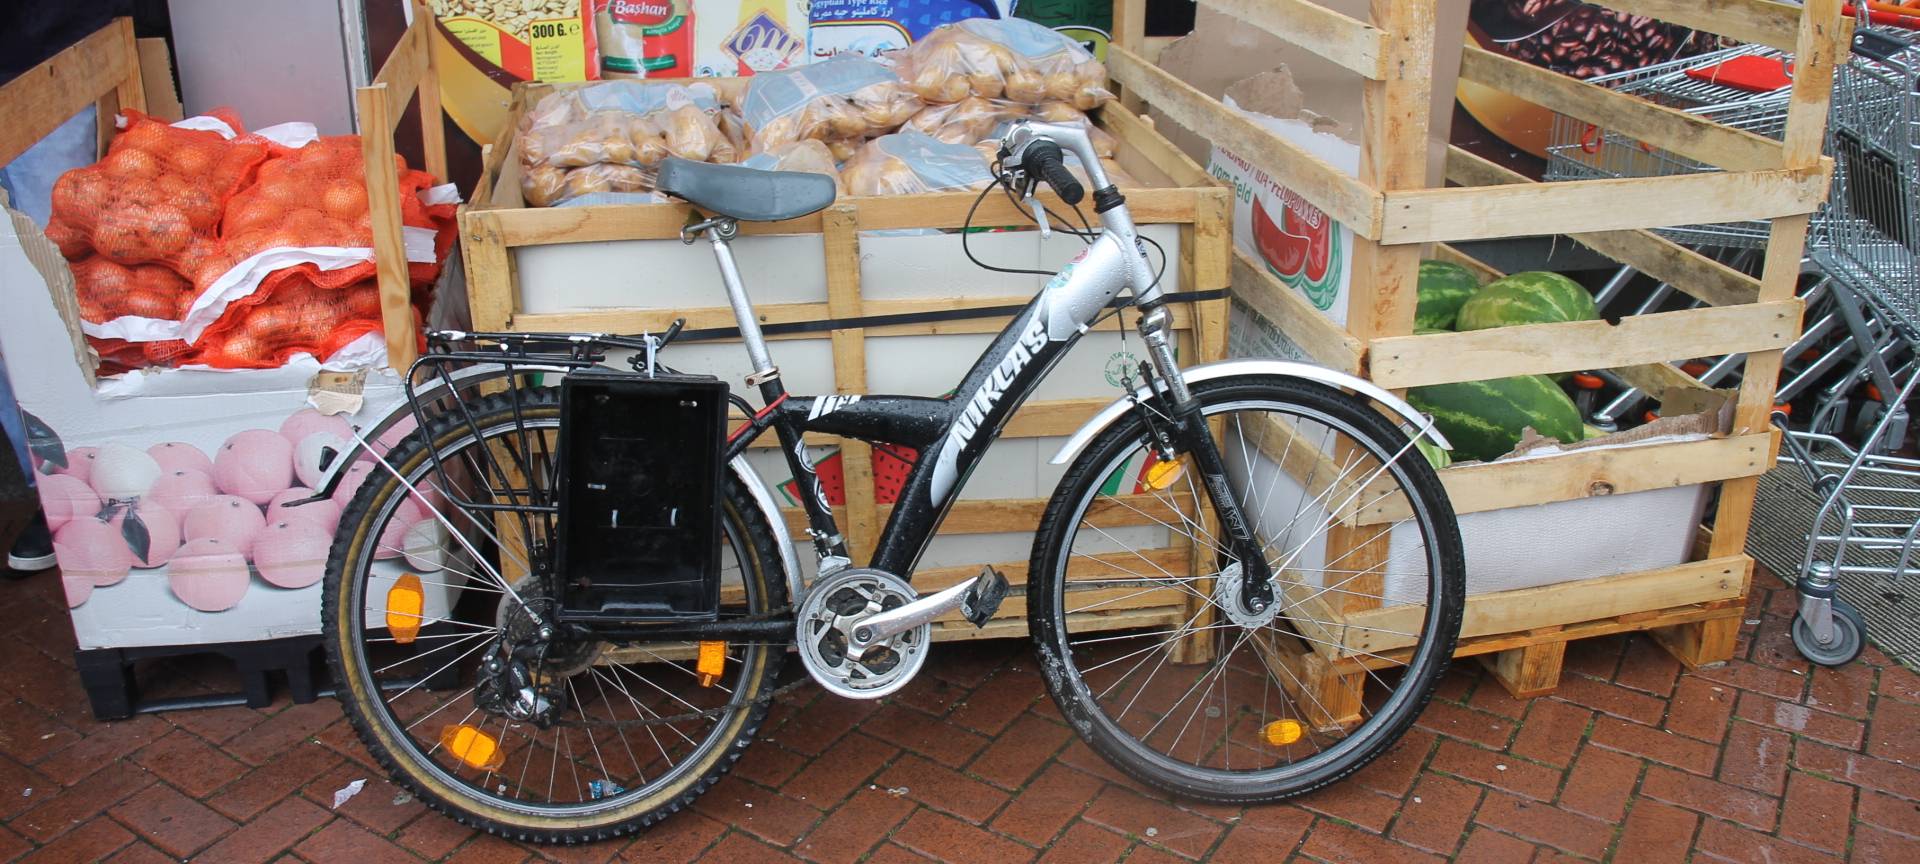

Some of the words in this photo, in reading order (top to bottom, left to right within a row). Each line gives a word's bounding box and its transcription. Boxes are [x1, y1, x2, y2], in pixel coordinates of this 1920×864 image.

[532, 24, 555, 39] 300
[557, 23, 567, 37] G.
[1232, 175, 1253, 205] Feld
[1110, 351, 1135, 361] ITAIA
[950, 319, 1050, 452] NIKLAS
